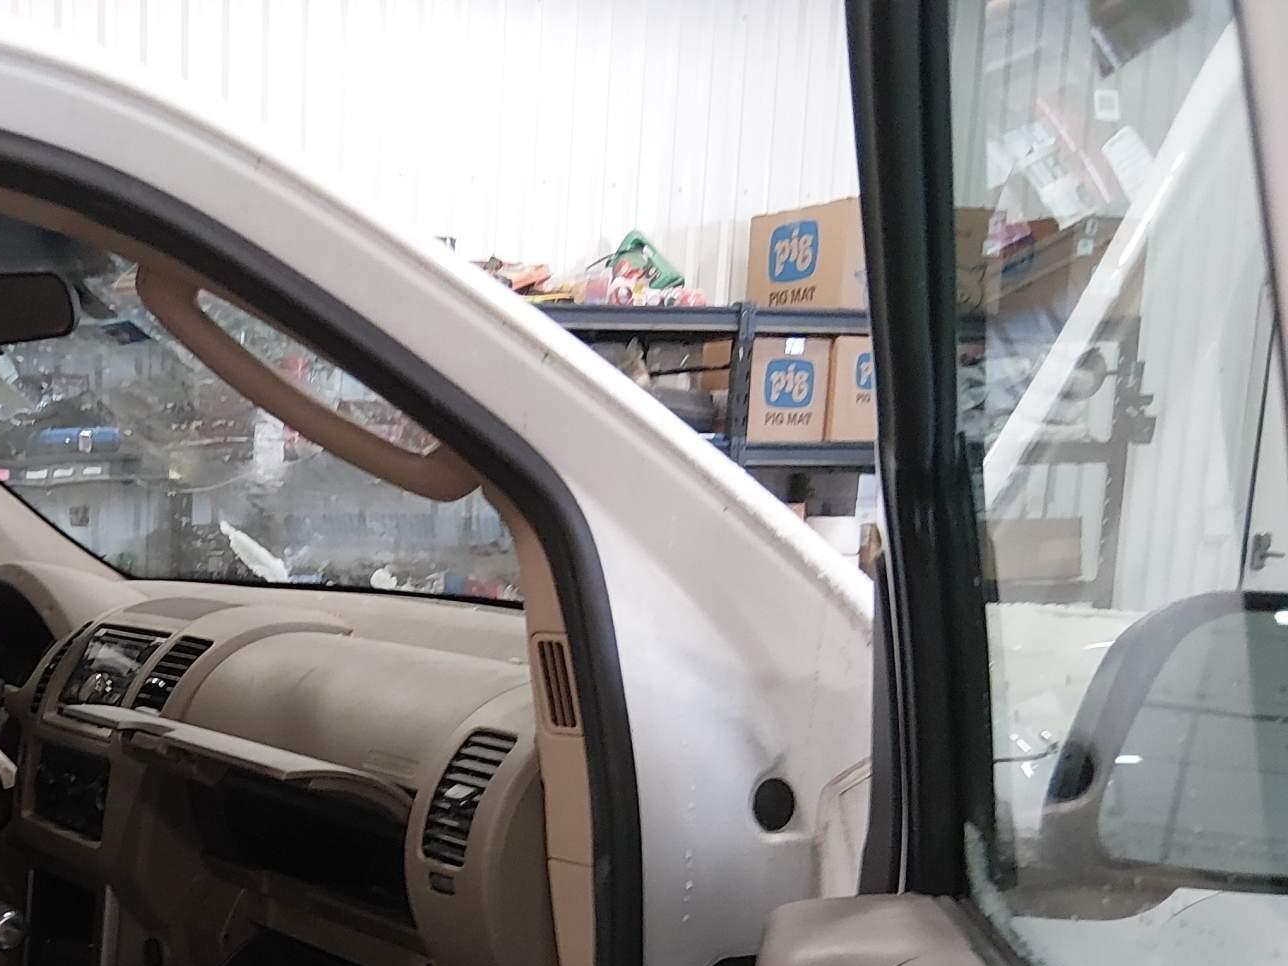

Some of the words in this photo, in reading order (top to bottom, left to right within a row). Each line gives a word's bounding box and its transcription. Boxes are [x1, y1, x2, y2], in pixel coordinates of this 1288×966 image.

[774, 228, 814, 277] pig
[768, 289, 789, 307] PIG
[791, 286, 816, 304] MAT
[770, 363, 810, 402] pig
[764, 411, 784, 425] PIG
[787, 411, 813, 425] MAT
